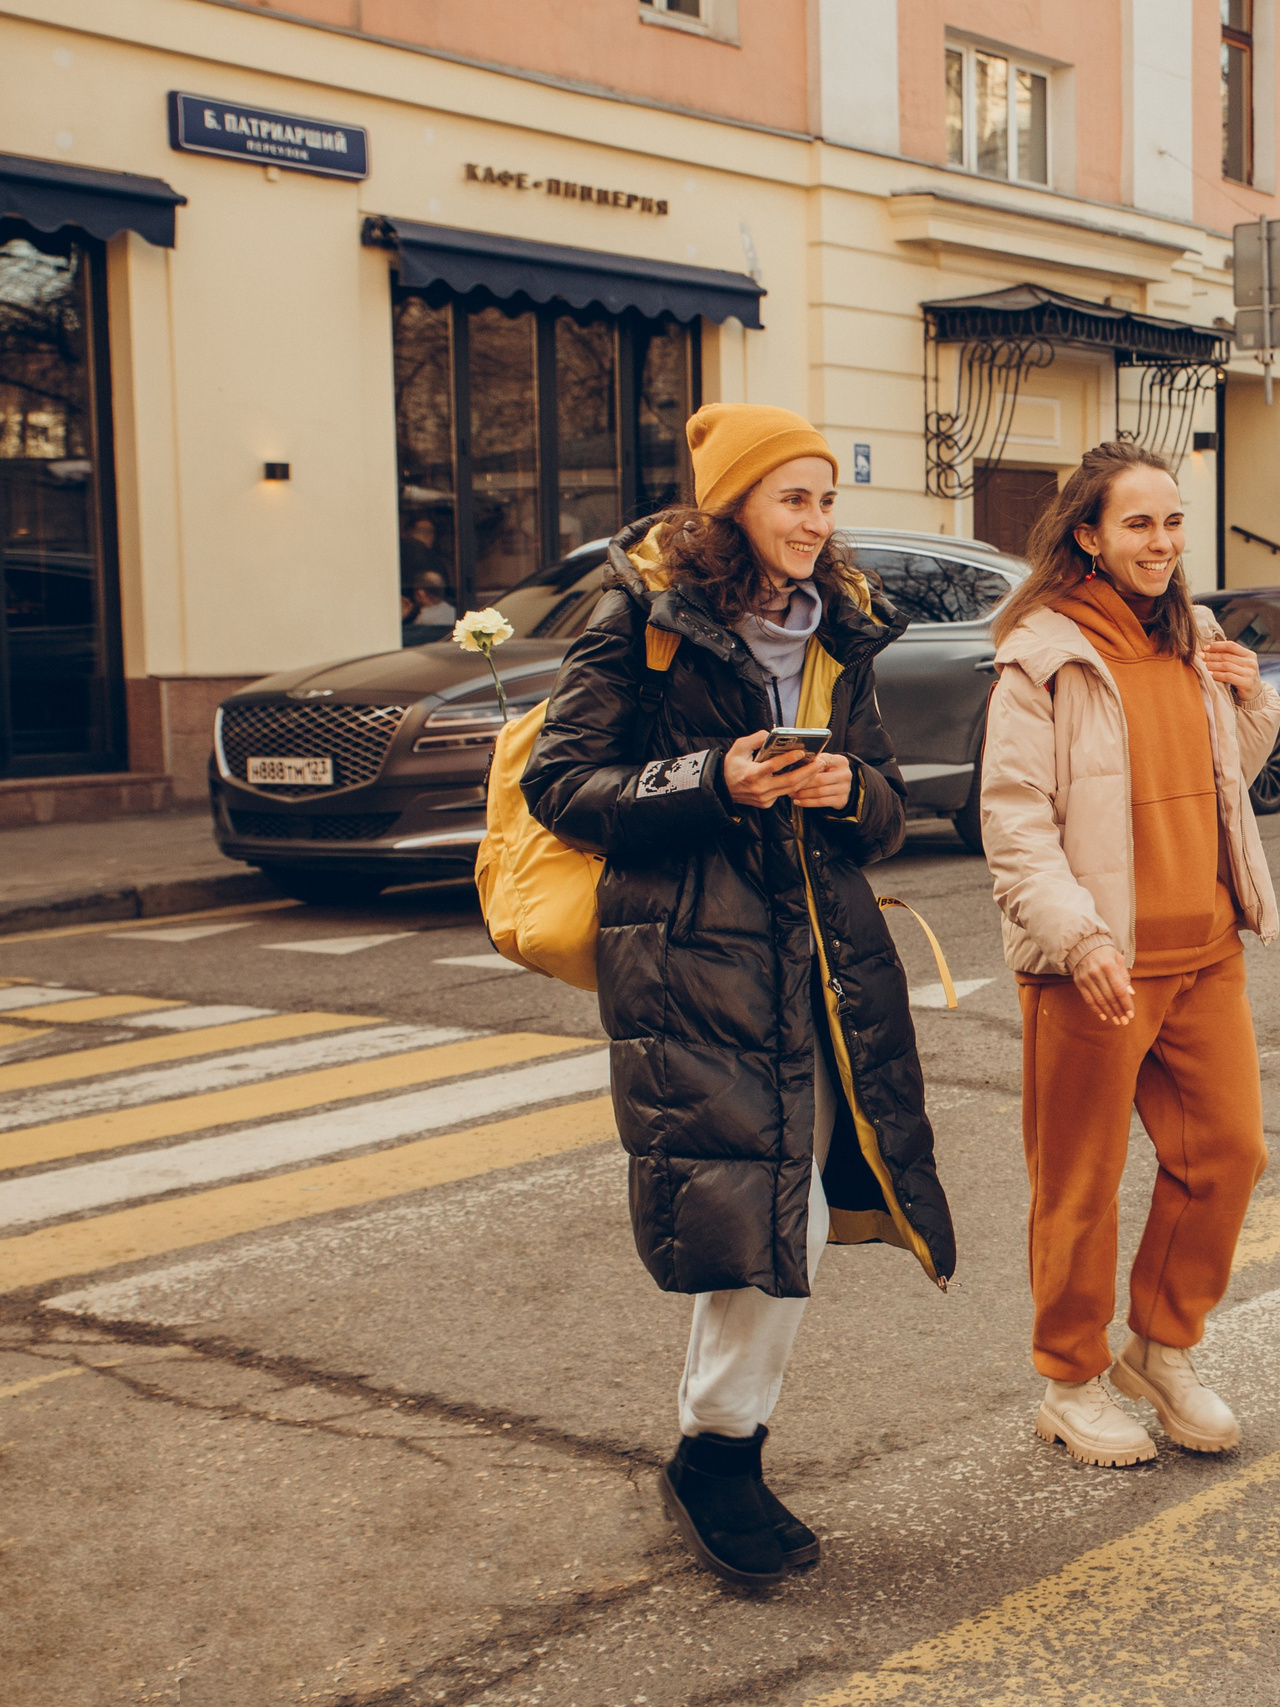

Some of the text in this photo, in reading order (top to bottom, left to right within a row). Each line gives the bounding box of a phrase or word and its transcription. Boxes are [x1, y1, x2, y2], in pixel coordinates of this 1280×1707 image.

[203, 108, 348, 154] Б. ПАТРИАРШИЙ
[246, 139, 310, 161] ПЕРЕУЛОК
